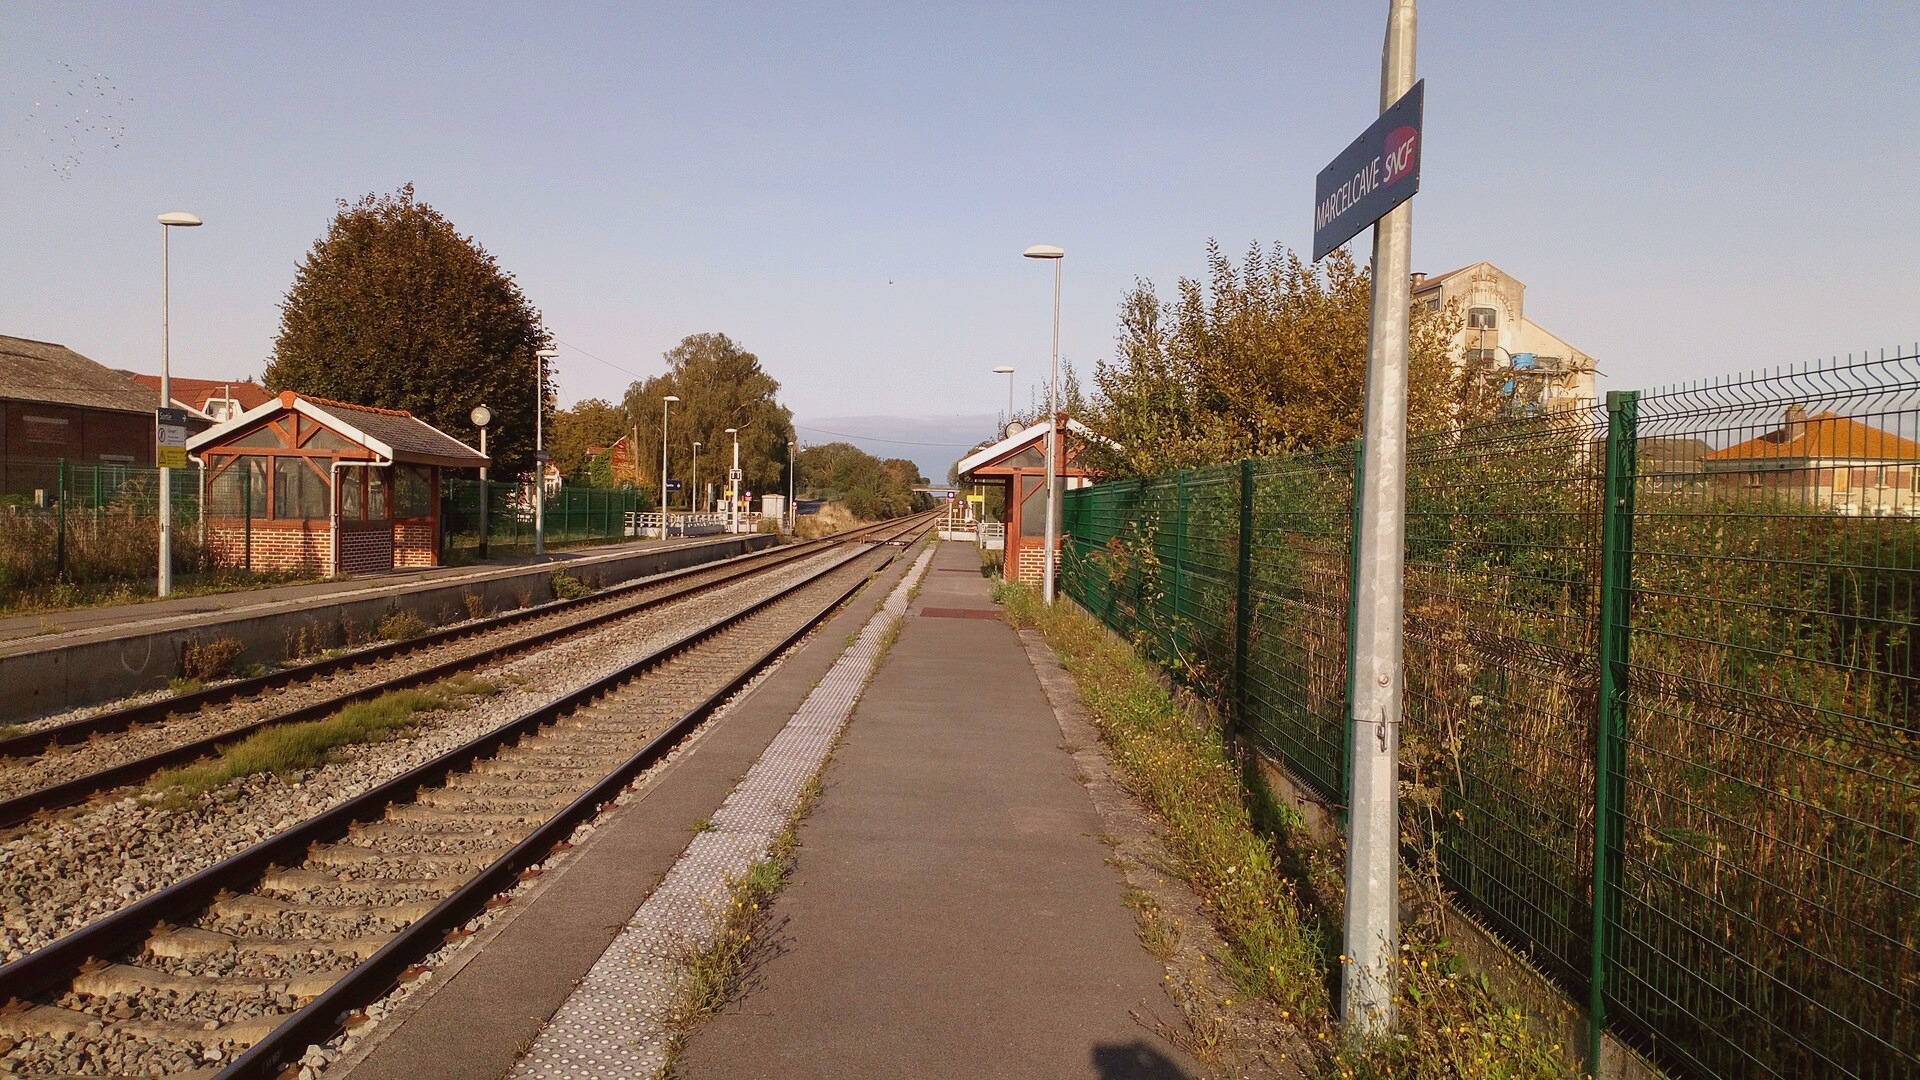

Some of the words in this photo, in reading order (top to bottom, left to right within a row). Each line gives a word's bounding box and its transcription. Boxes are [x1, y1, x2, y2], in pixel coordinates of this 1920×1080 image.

[1316, 156, 1380, 232] MARCELCAVE
[1383, 136, 1415, 183] SNCF
[1471, 273, 1499, 284] SILOS
